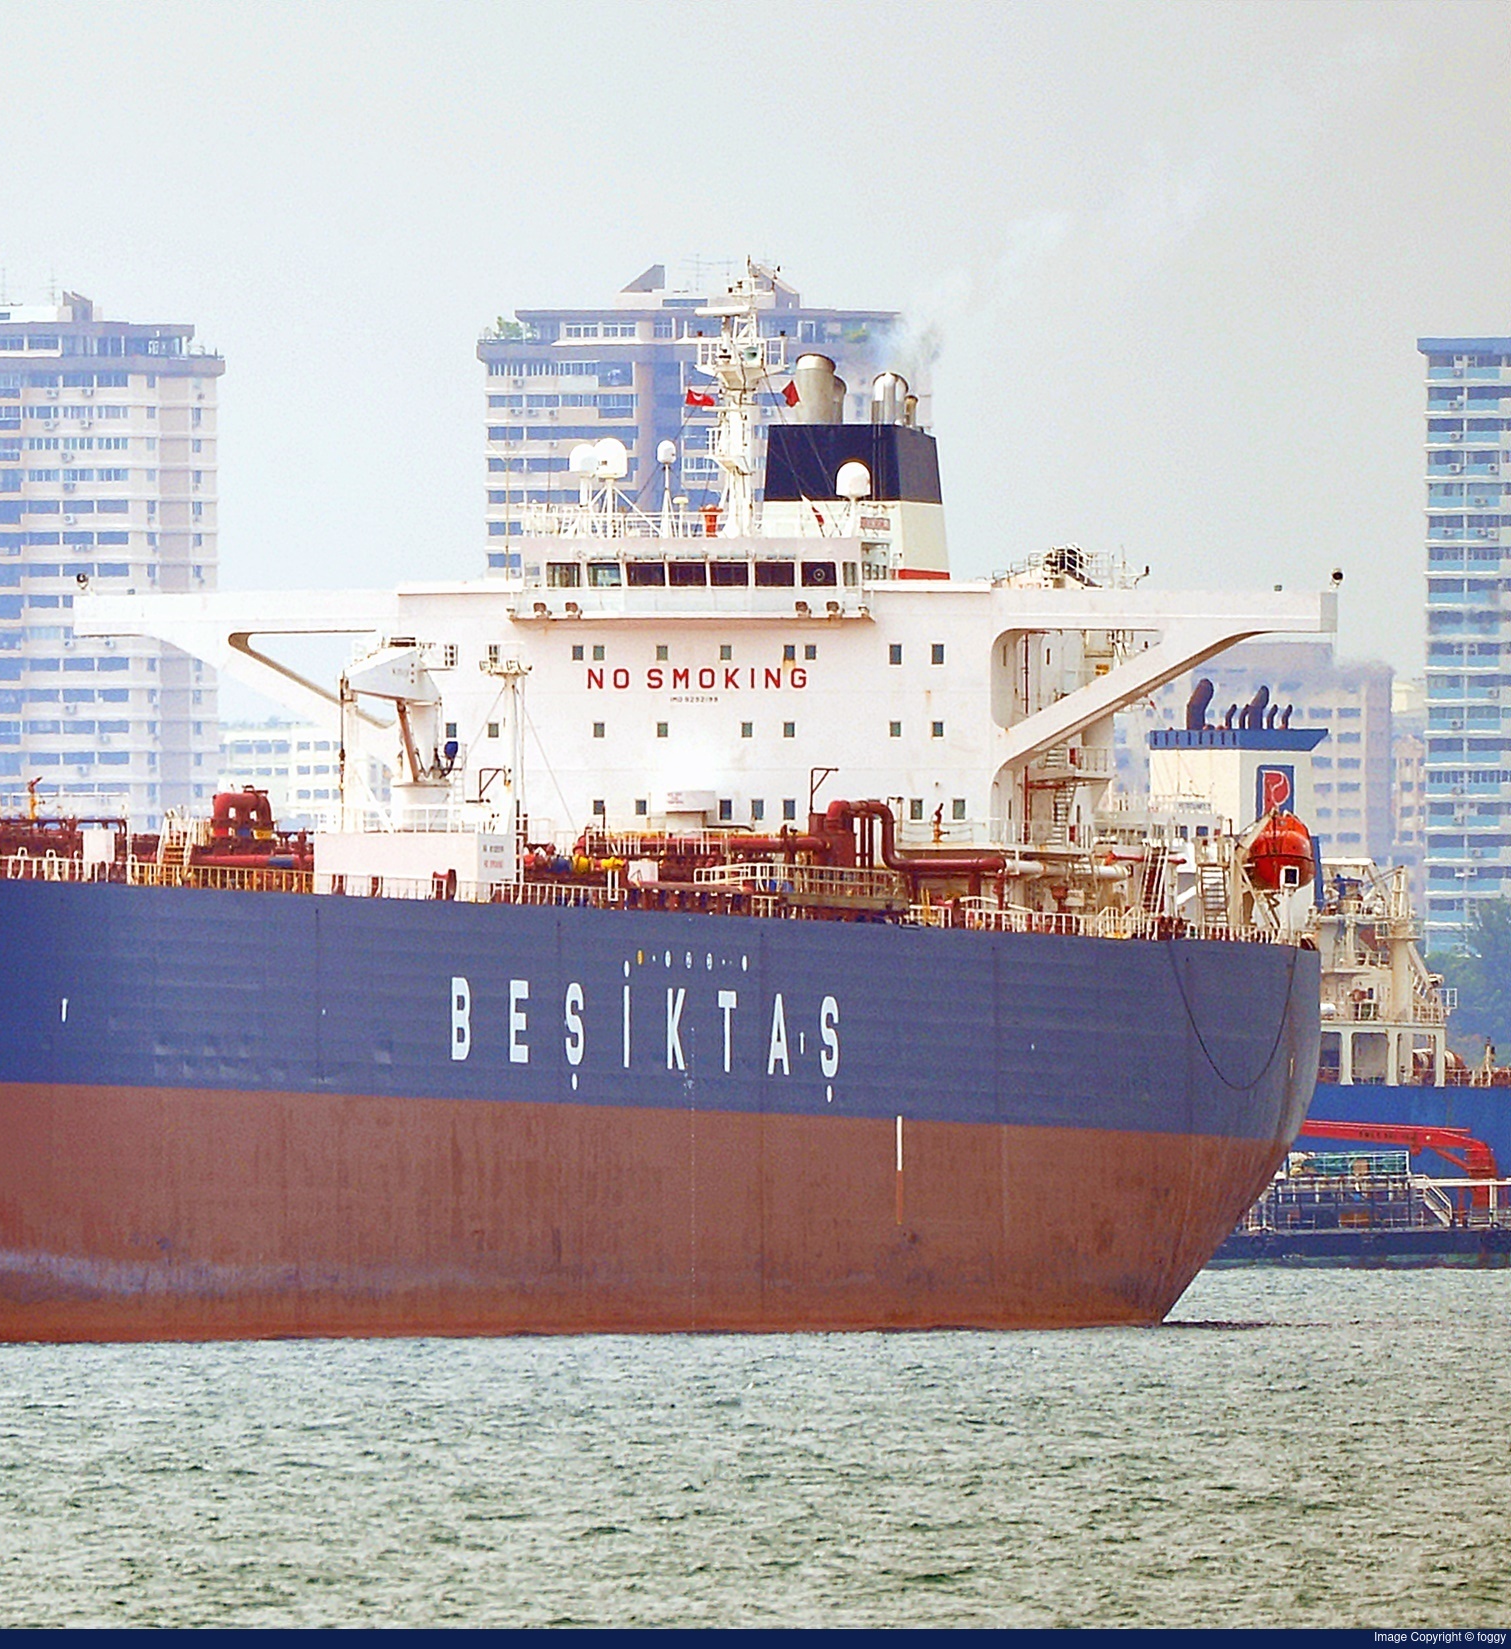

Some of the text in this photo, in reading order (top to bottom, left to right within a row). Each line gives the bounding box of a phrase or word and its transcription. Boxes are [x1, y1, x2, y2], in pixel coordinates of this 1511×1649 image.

[587, 668, 807, 690] NO SMOKING
[451, 960, 840, 1103] BEŞİKTAŞ
